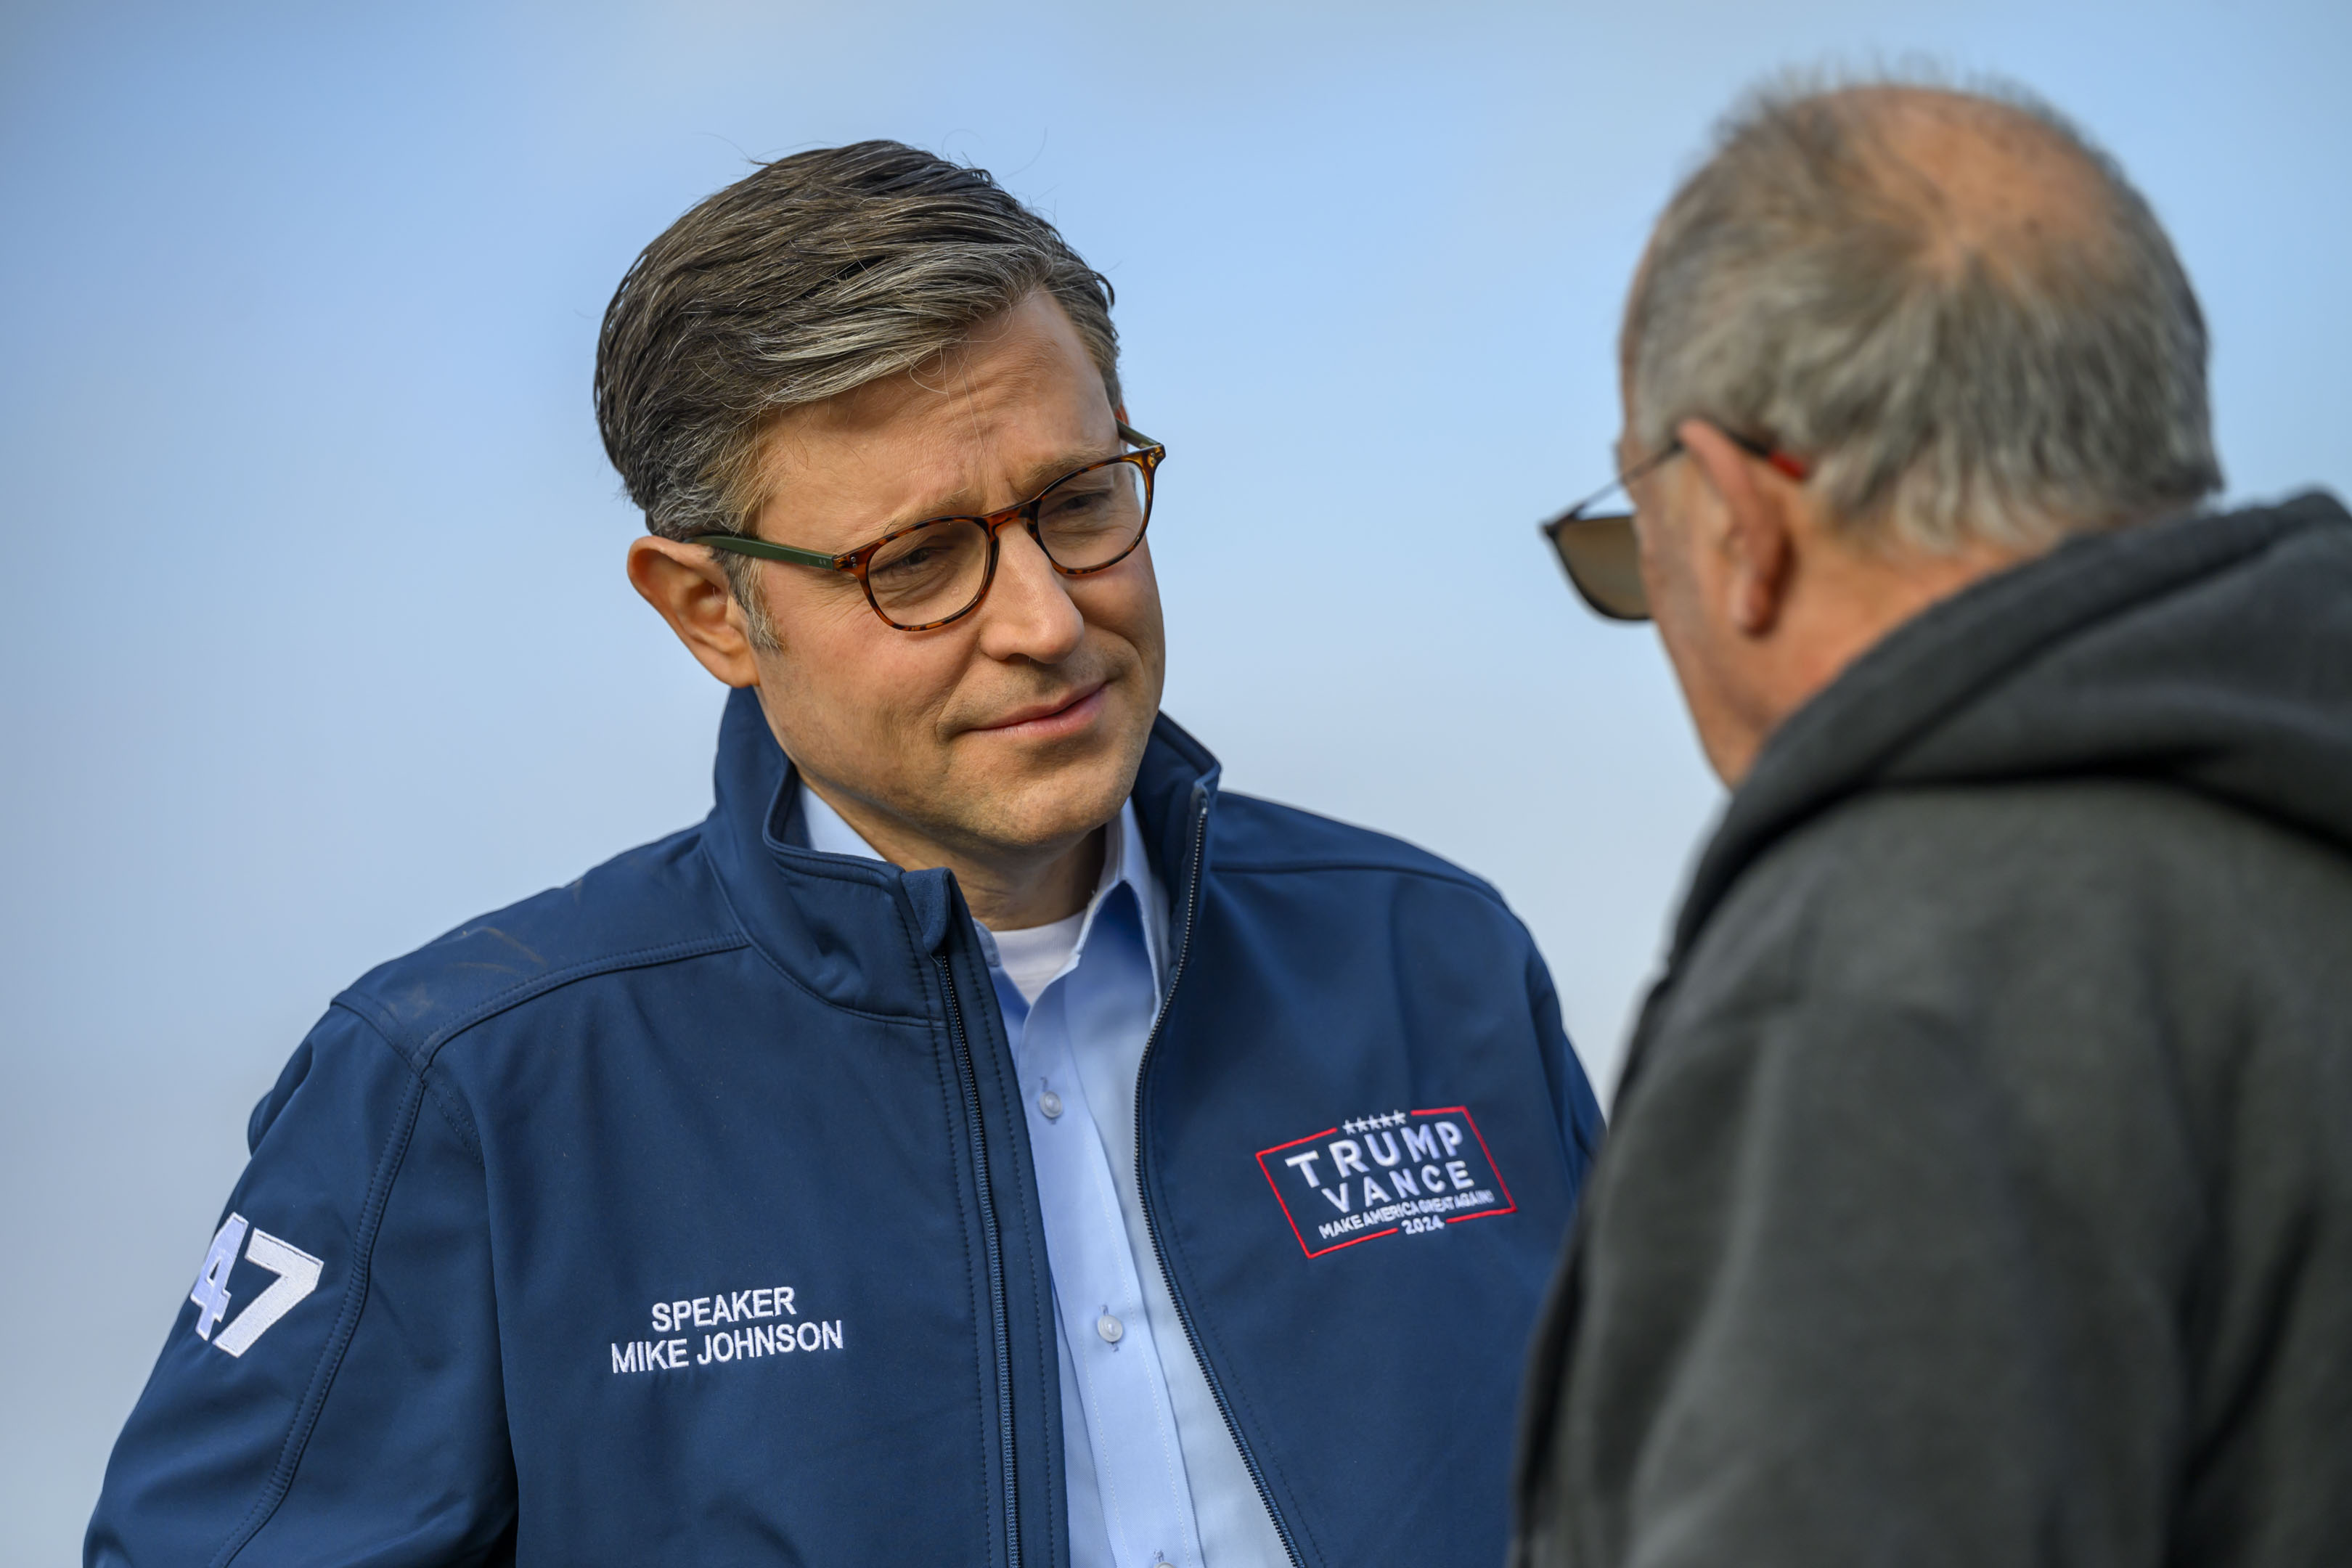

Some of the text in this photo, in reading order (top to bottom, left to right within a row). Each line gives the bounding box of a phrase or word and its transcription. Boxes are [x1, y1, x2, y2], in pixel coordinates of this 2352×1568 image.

[1284, 1120, 1464, 1188] TRUMP
[1320, 1160, 1475, 1214] VANCE
[1318, 1214, 1364, 1239] MAKE
[1362, 1200, 1420, 1226] AMERICA
[1418, 1196, 1455, 1213] GREAT
[1401, 1214, 1445, 1235] 2024
[190, 1212, 324, 1358] 47
[652, 1286, 797, 1332] SPEAKER
[611, 1320, 844, 1373] MIKE JOHNSON
